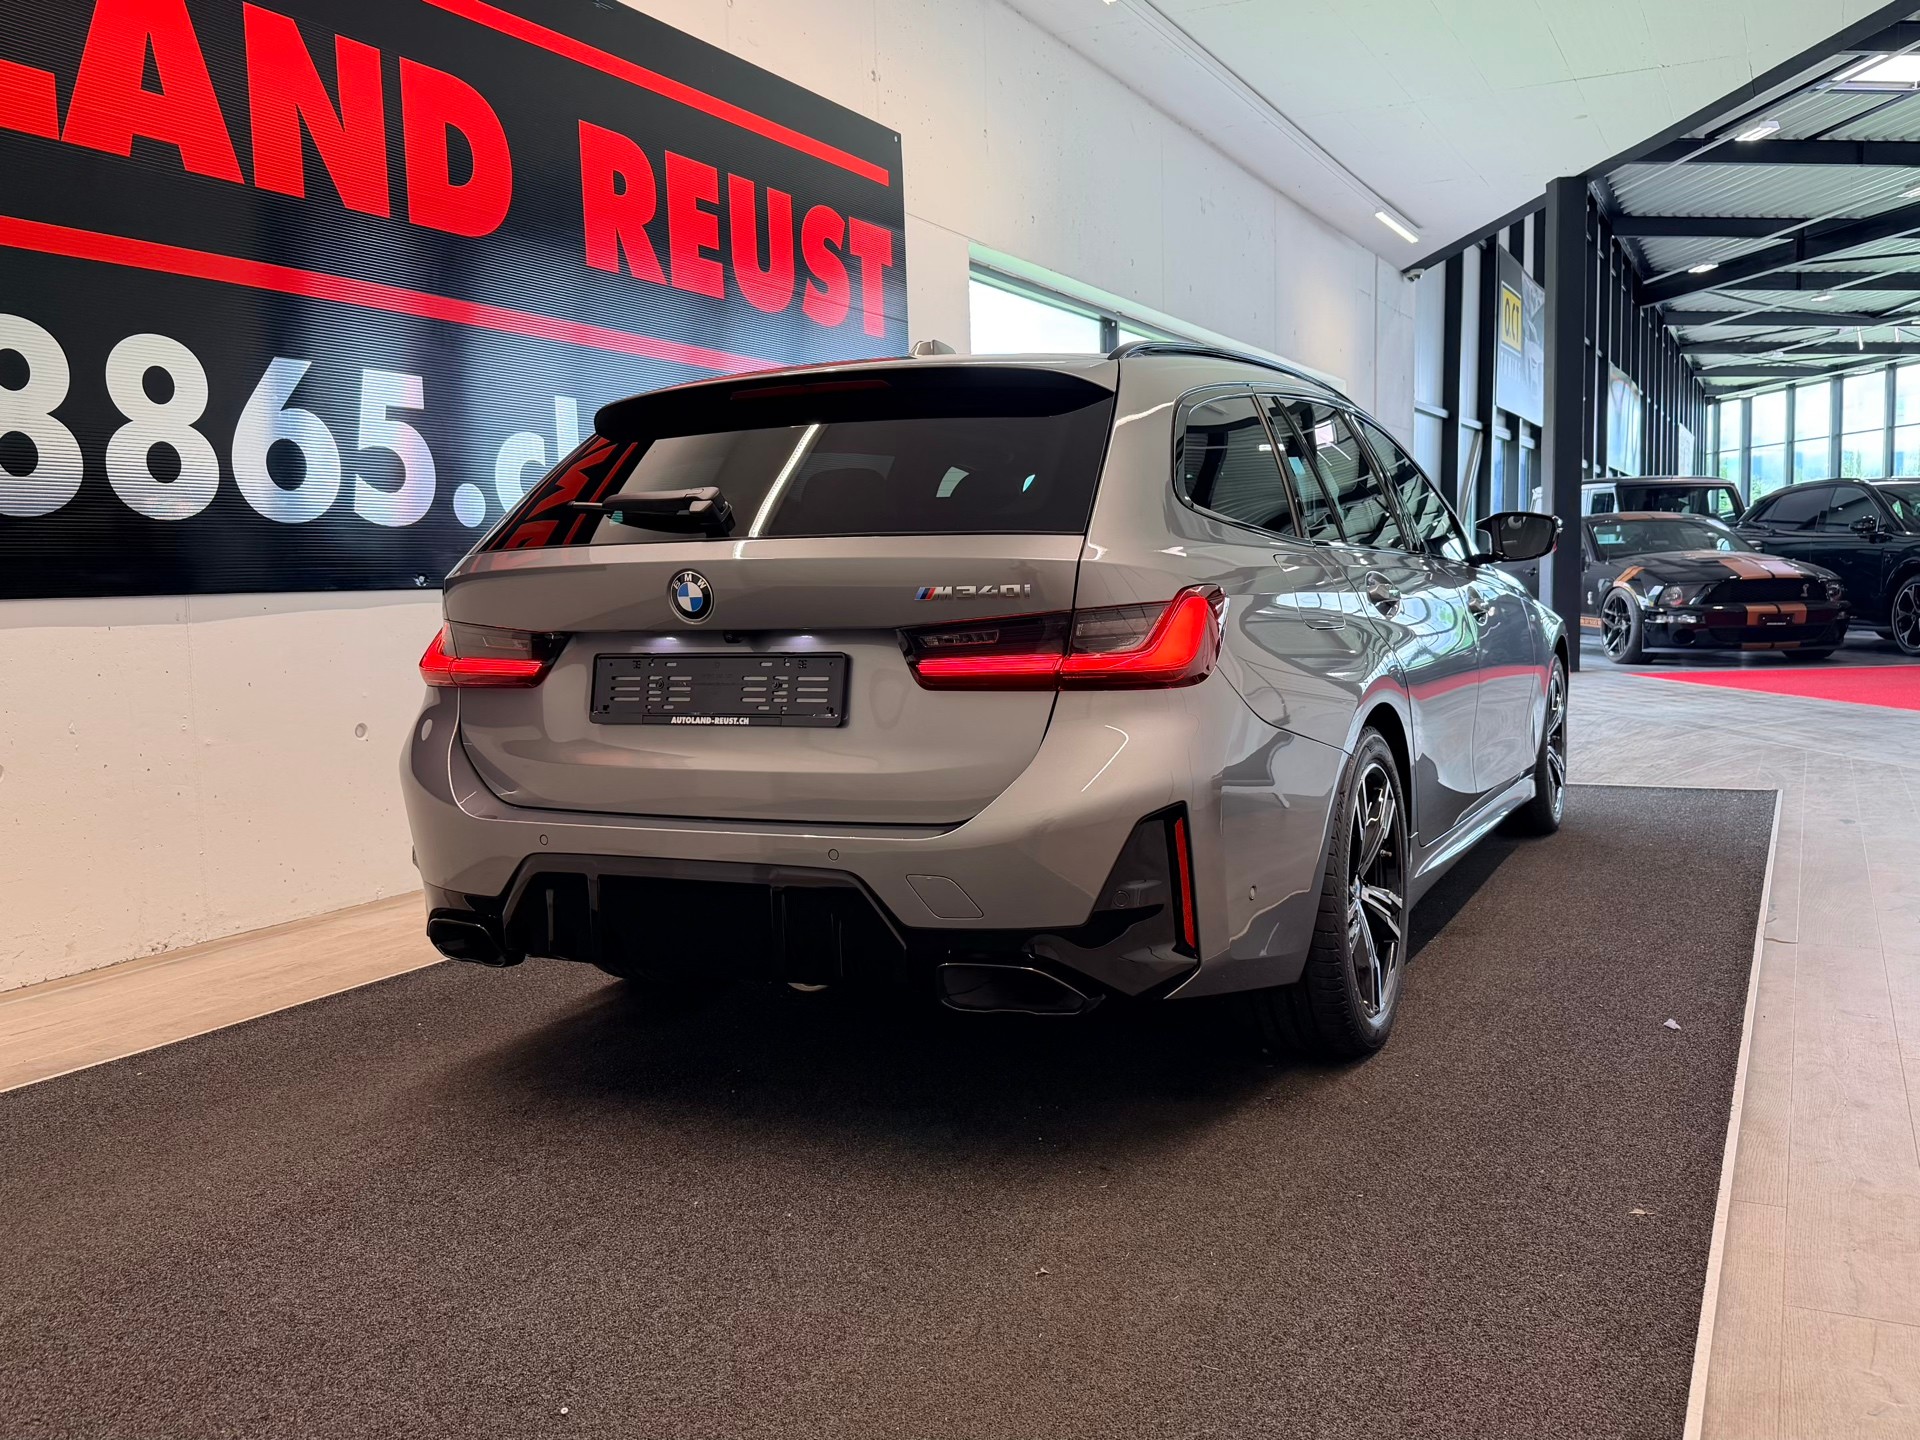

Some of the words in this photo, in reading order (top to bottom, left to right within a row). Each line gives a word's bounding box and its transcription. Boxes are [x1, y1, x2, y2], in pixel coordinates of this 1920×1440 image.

[578, 119, 893, 339] REUST
[673, 573, 707, 590] BMW
[914, 583, 1031, 600] M340i
[670, 716, 750, 725] AUTOLAND-REUST.CH
